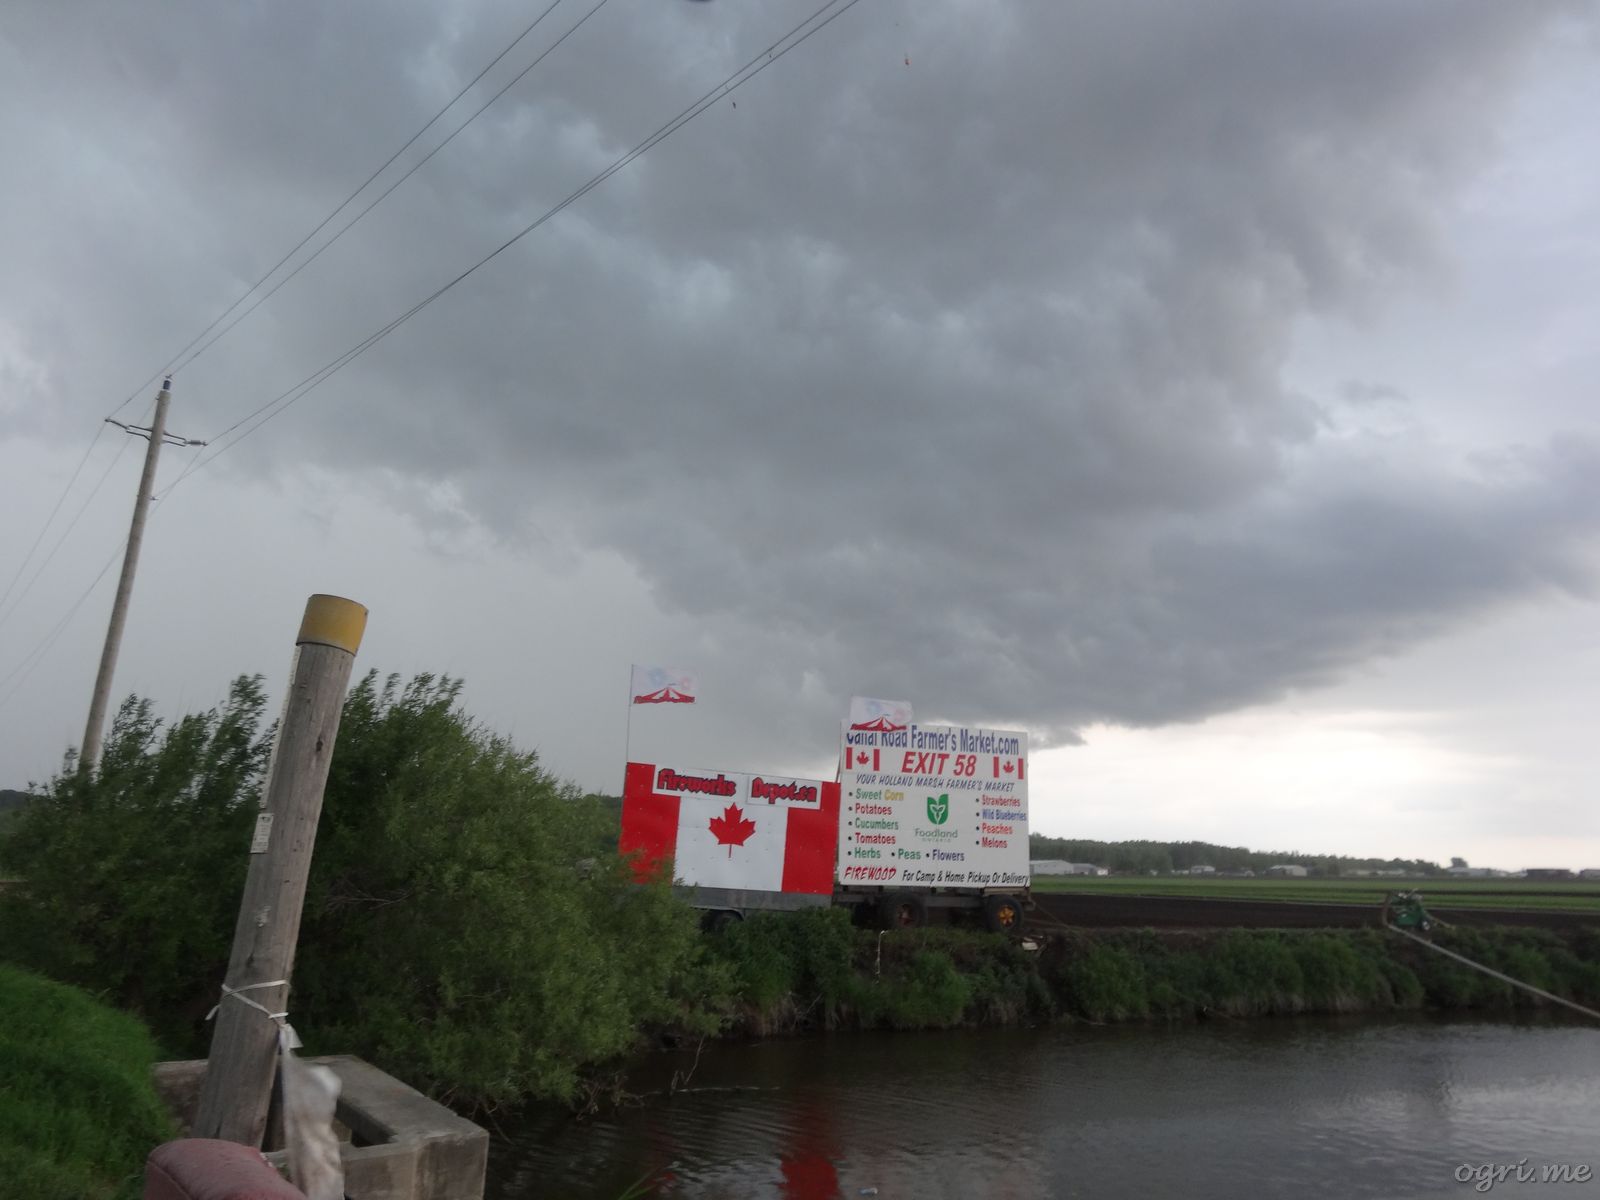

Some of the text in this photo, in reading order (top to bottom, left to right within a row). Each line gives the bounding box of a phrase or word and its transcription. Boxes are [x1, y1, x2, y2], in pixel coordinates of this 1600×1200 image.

[911, 725, 957, 752] Farmer's
[960, 728, 1019, 755] Market.com
[901, 751, 977, 777] EXIT 58
[656, 768, 737, 797] Fireworks
[856, 774, 1016, 793] YOUR HOLLAND MARSH FARMER'S MARKET
[856, 789, 904, 801] Sweet Corn
[982, 794, 1021, 808] Strawberries
[855, 803, 892, 815] Potatoes
[982, 809, 994, 820] Wild
[855, 817, 899, 830] Cucumbers
[982, 822, 1013, 835] Peaches
[855, 832, 896, 844] Tomatoes
[914, 827, 958, 838] Foodland
[982, 836, 1008, 848] Melons
[854, 847, 965, 862] Herbs Peas Flowers
[844, 866, 1029, 888] FIREWOOD For Camp & Home Pickup Or Delivery
